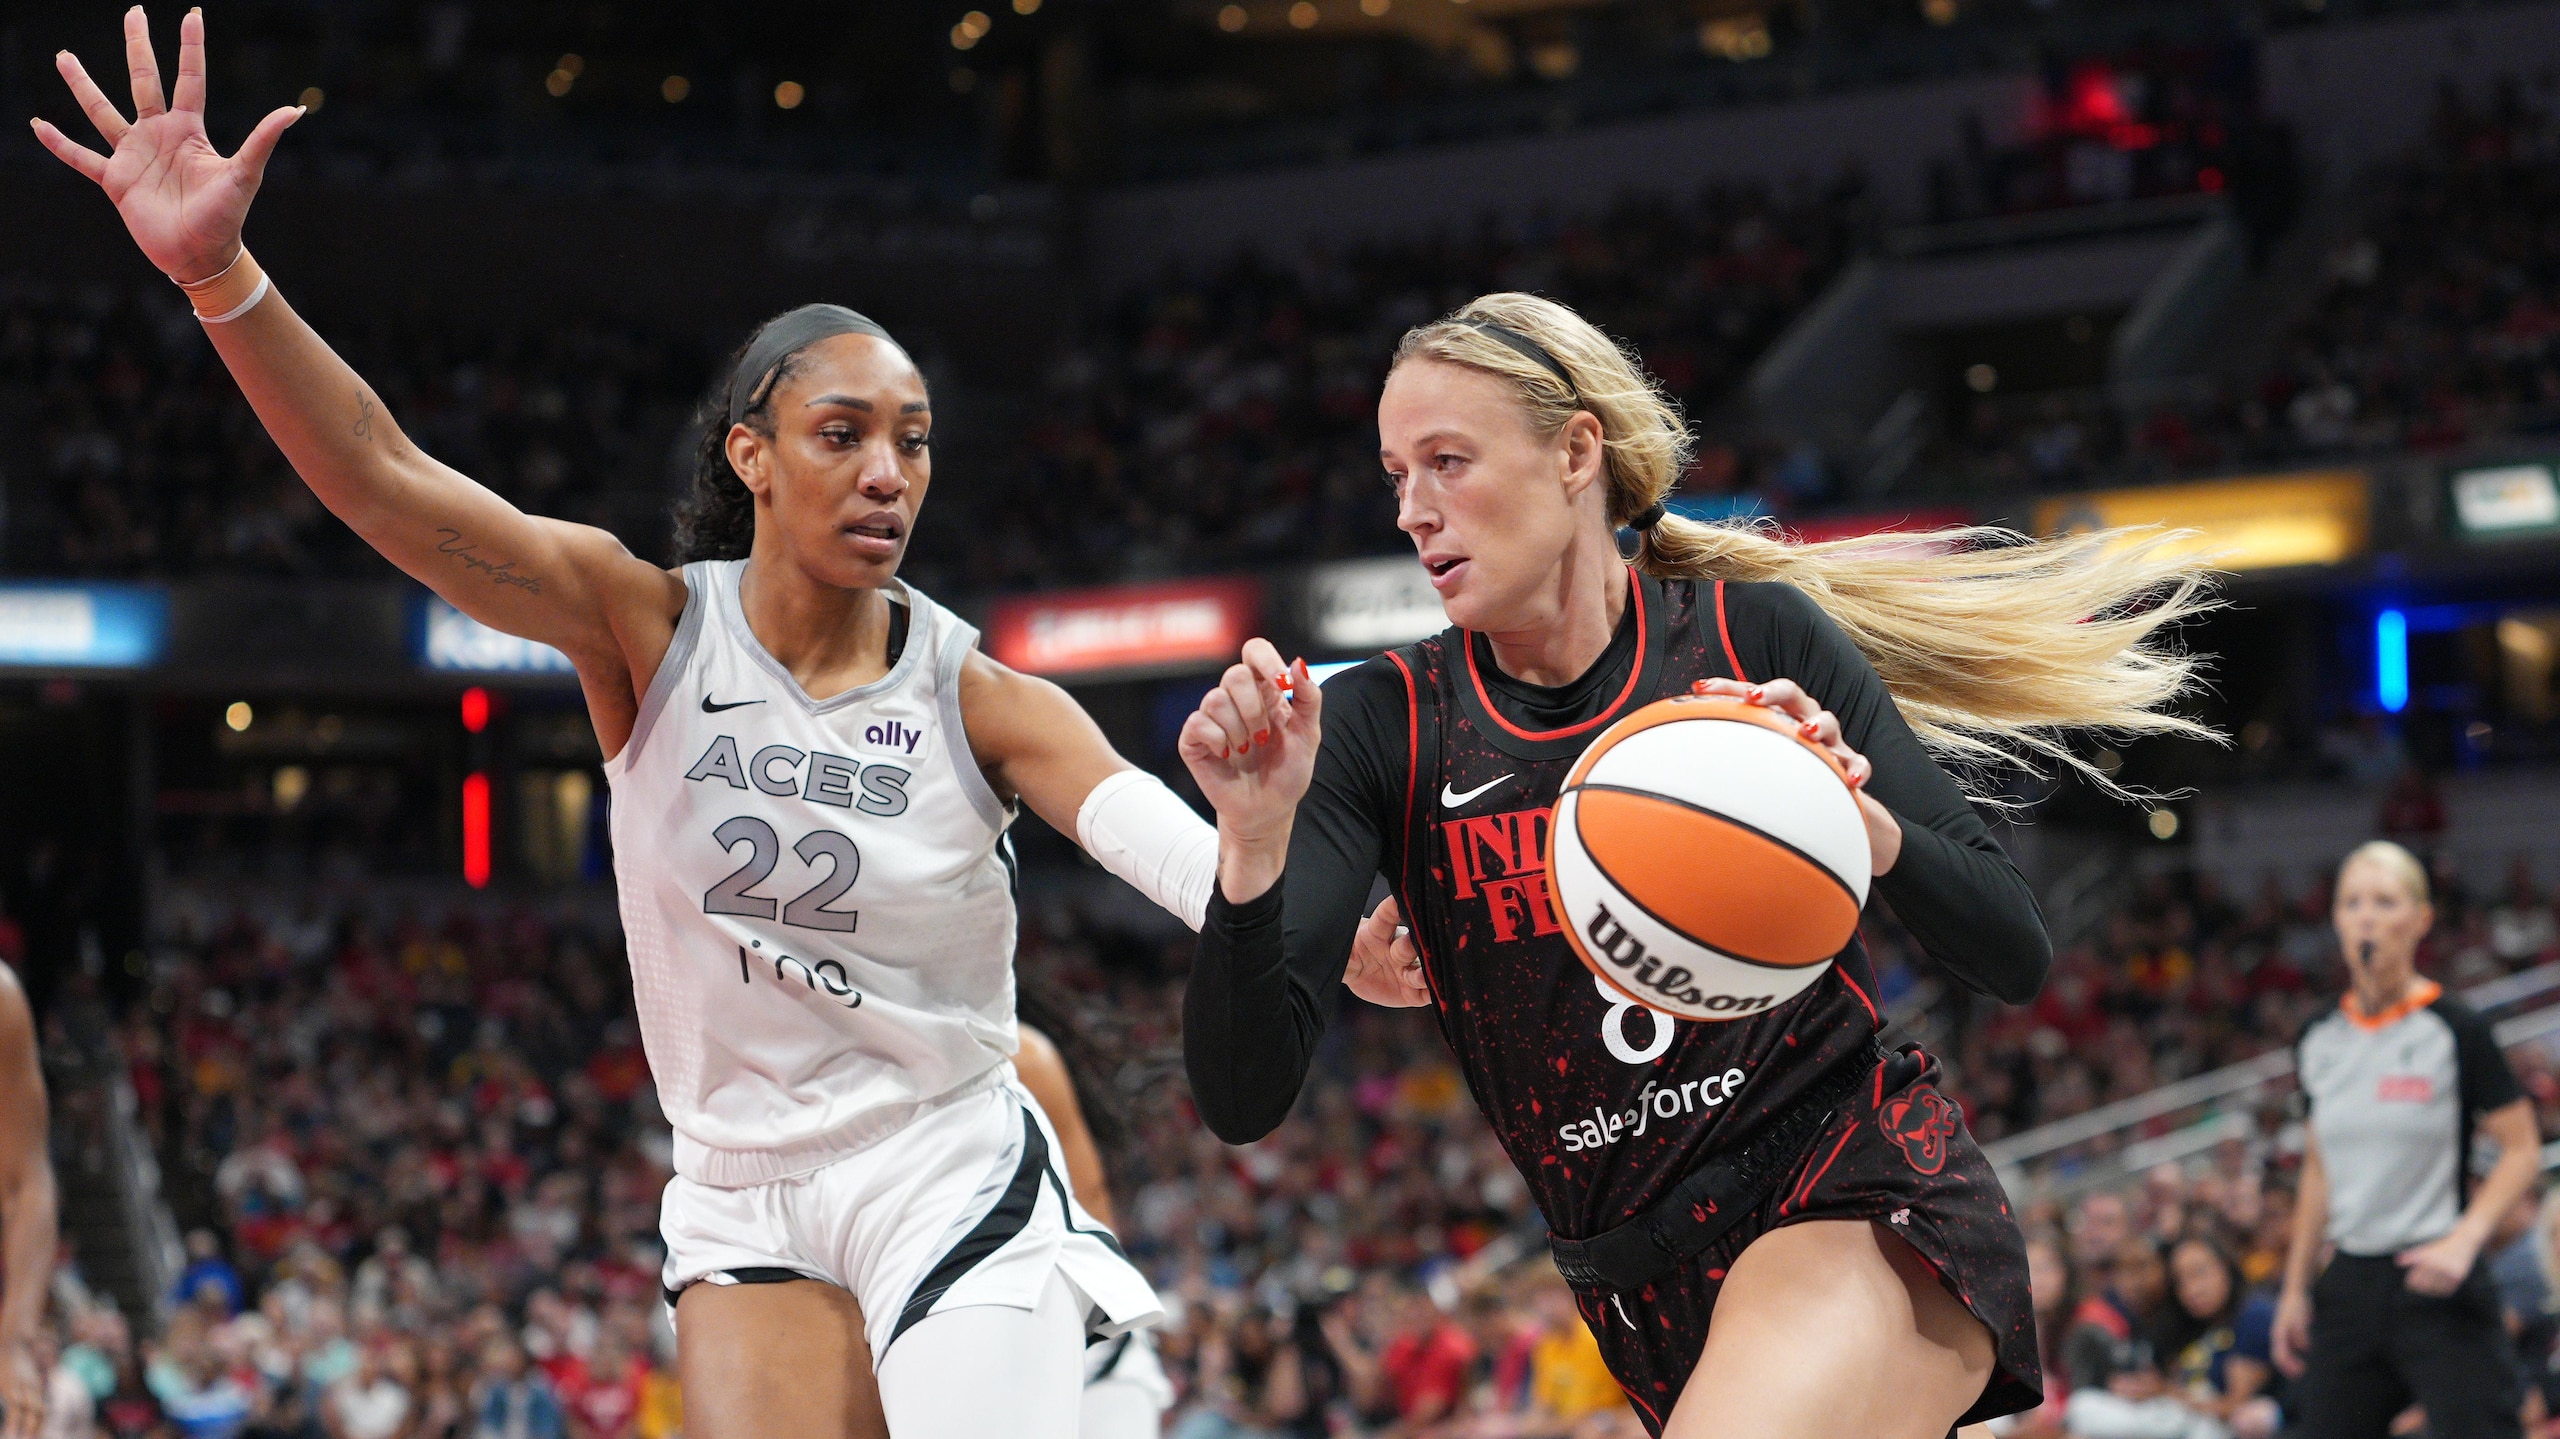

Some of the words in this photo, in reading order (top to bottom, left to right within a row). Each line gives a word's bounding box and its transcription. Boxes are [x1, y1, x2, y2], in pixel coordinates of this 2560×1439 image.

[685, 735, 911, 817] ACES
[865, 720, 922, 754] ally
[703, 816, 860, 933] 22
[1588, 902, 1776, 1012] Wilson
